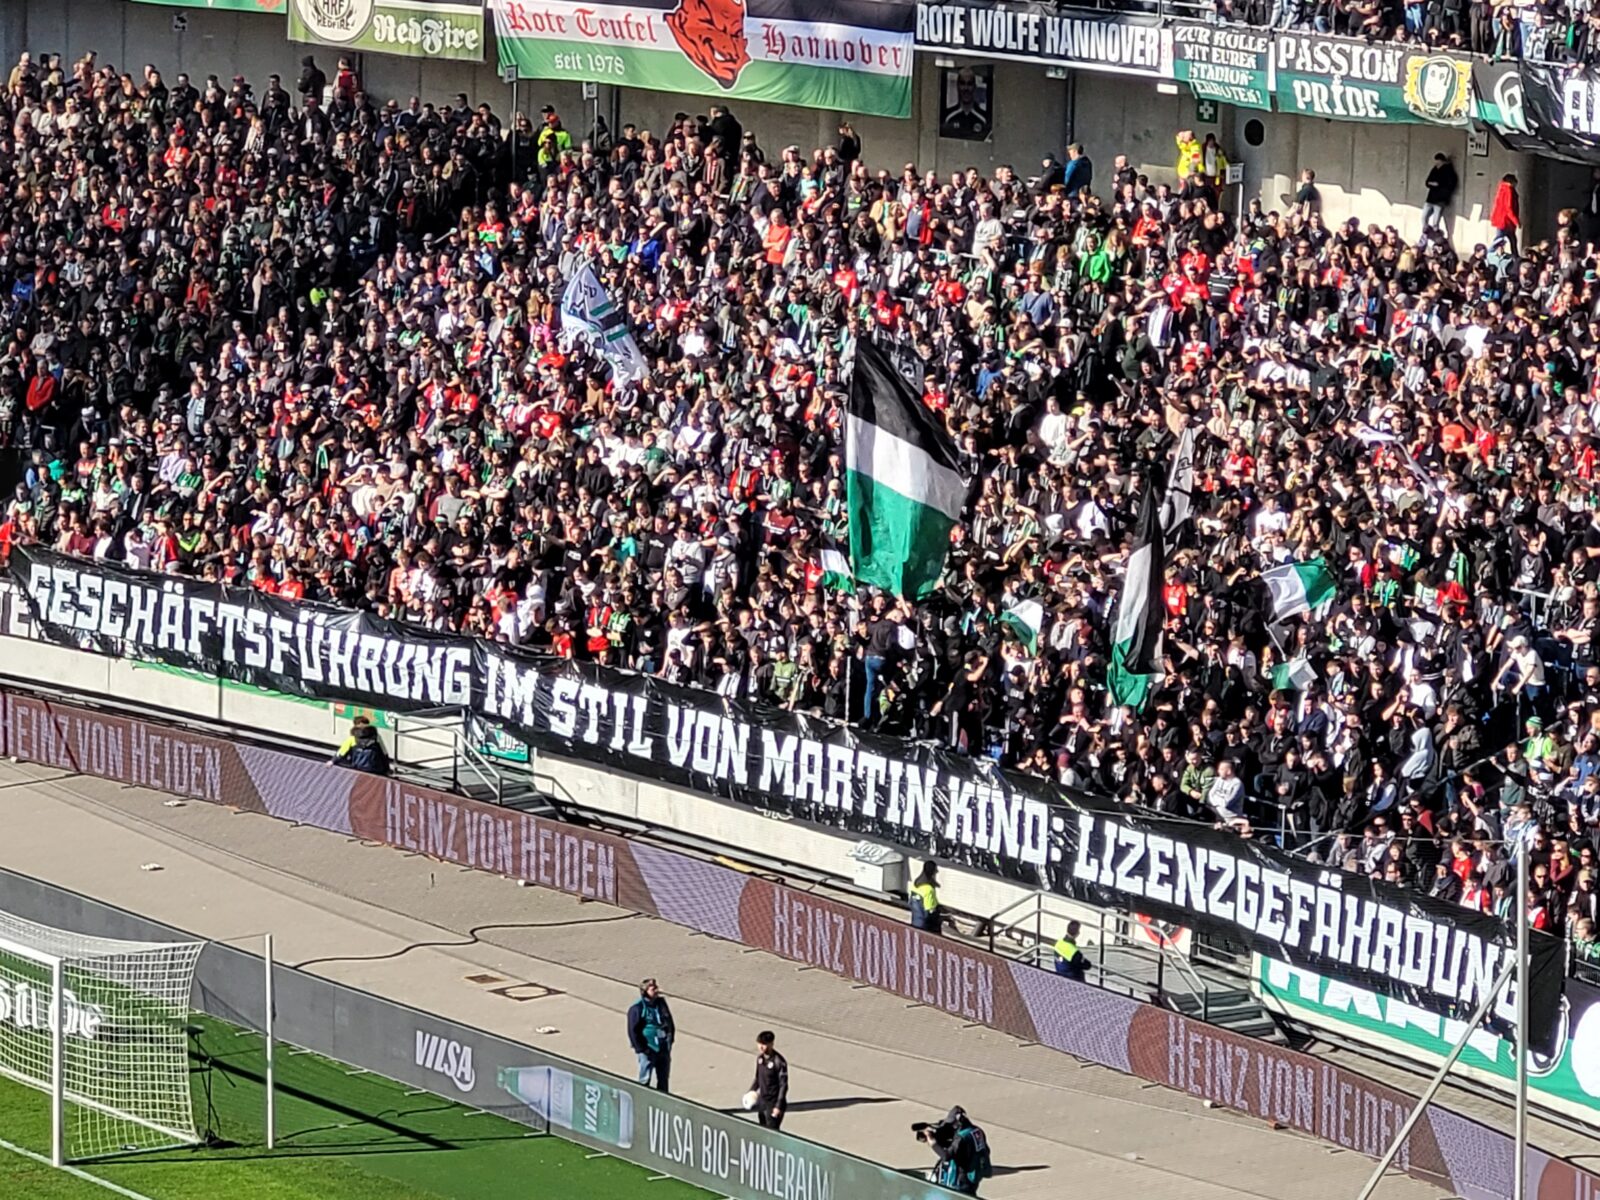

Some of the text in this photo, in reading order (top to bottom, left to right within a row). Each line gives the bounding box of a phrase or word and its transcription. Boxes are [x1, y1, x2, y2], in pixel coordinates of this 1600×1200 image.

[373, 14, 479, 54] RedFire
[507, 1, 902, 69] Rote Teufel Hannover
[554, 51, 626, 75] seit 1978
[916, 3, 965, 45] ROTE
[970, 4, 1039, 52] WÖLFE
[1044, 16, 1160, 67] HANNOVER
[1175, 26, 1268, 53] ZUR HÖLLE
[1184, 43, 1210, 62] MIT
[1211, 46, 1257, 69] EUREN
[1278, 36, 1403, 83] PASSION
[1293, 79, 1388, 119] PRIDE
[0, 692, 221, 800] HEINZ VON HEIDEN
[28, 563, 471, 705] GESCHÄFTSFÜHRUNG
[484, 652, 539, 726] IM
[549, 676, 654, 759] STIL
[667, 704, 751, 785] VON
[759, 728, 939, 833] MARTIN
[946, 776, 1064, 866] KIND:
[1073, 813, 1532, 1025] LIZENZGEFÄHRDUNG
[385, 781, 615, 900] HEINZ VON HEIDEN
[774, 887, 993, 1023] HEINZ VON HEIDEN
[415, 1030, 476, 1092] VILSA
[1168, 1014, 1249, 1112] HEINZ
[1257, 1053, 1314, 1131] VON
[584, 1084, 602, 1133] VILSA
[648, 1106, 694, 1167] VILSA
